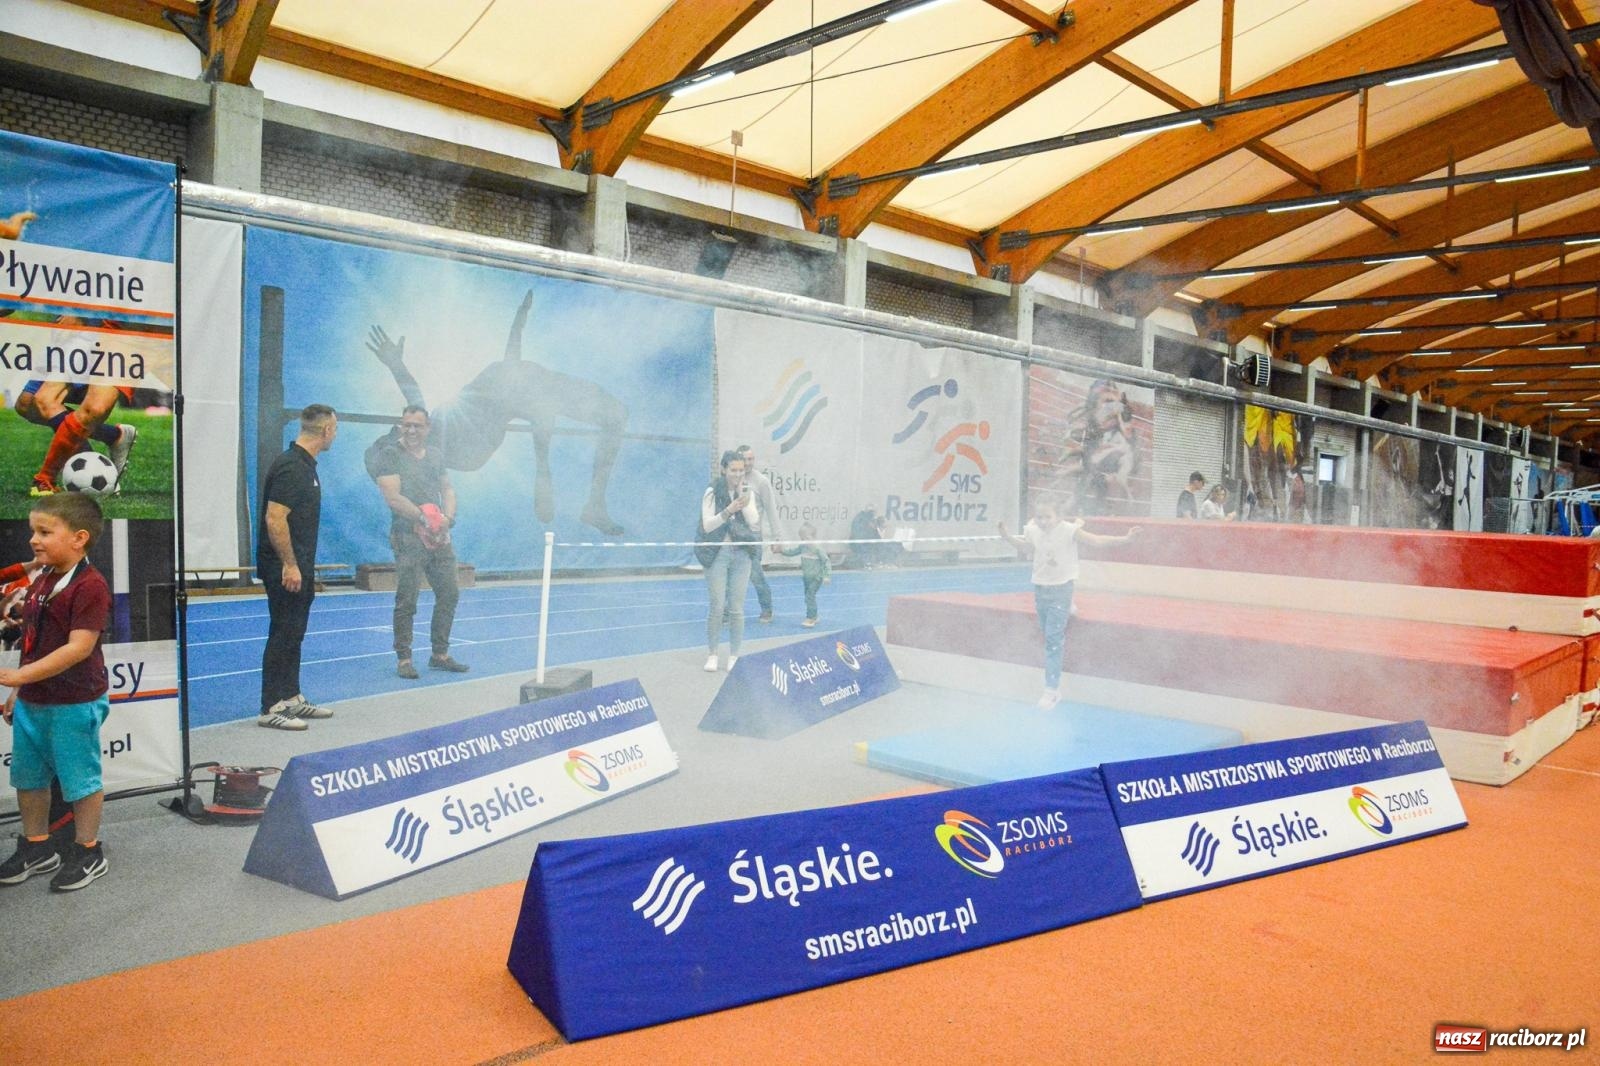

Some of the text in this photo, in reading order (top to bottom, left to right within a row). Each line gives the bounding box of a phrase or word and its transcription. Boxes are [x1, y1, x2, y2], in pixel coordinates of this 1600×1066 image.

[0, 249, 144, 303] ływanie
[46, 342, 145, 380] nożna
[761, 468, 821, 496] ląskie.
[949, 473, 982, 494] SMS
[789, 656, 833, 684] Śląskie.
[310, 696, 649, 797] SZKOŁA MISTRZOSTWA SPORTOWEGO w Raciborzu
[600, 744, 644, 771] ZSOMS
[1117, 738, 1436, 804] SZKOŁA MISTRZOSTWA SPORTOWEGO w Raciborzu
[441, 782, 545, 836] Śląskie.
[1384, 788, 1429, 812] ZSOMS
[997, 811, 1068, 844] ZSOMS
[1231, 810, 1328, 857] Śląskie.
[728, 843, 893, 907] Śląskie.
[805, 897, 978, 960] smsraciborz.pl
